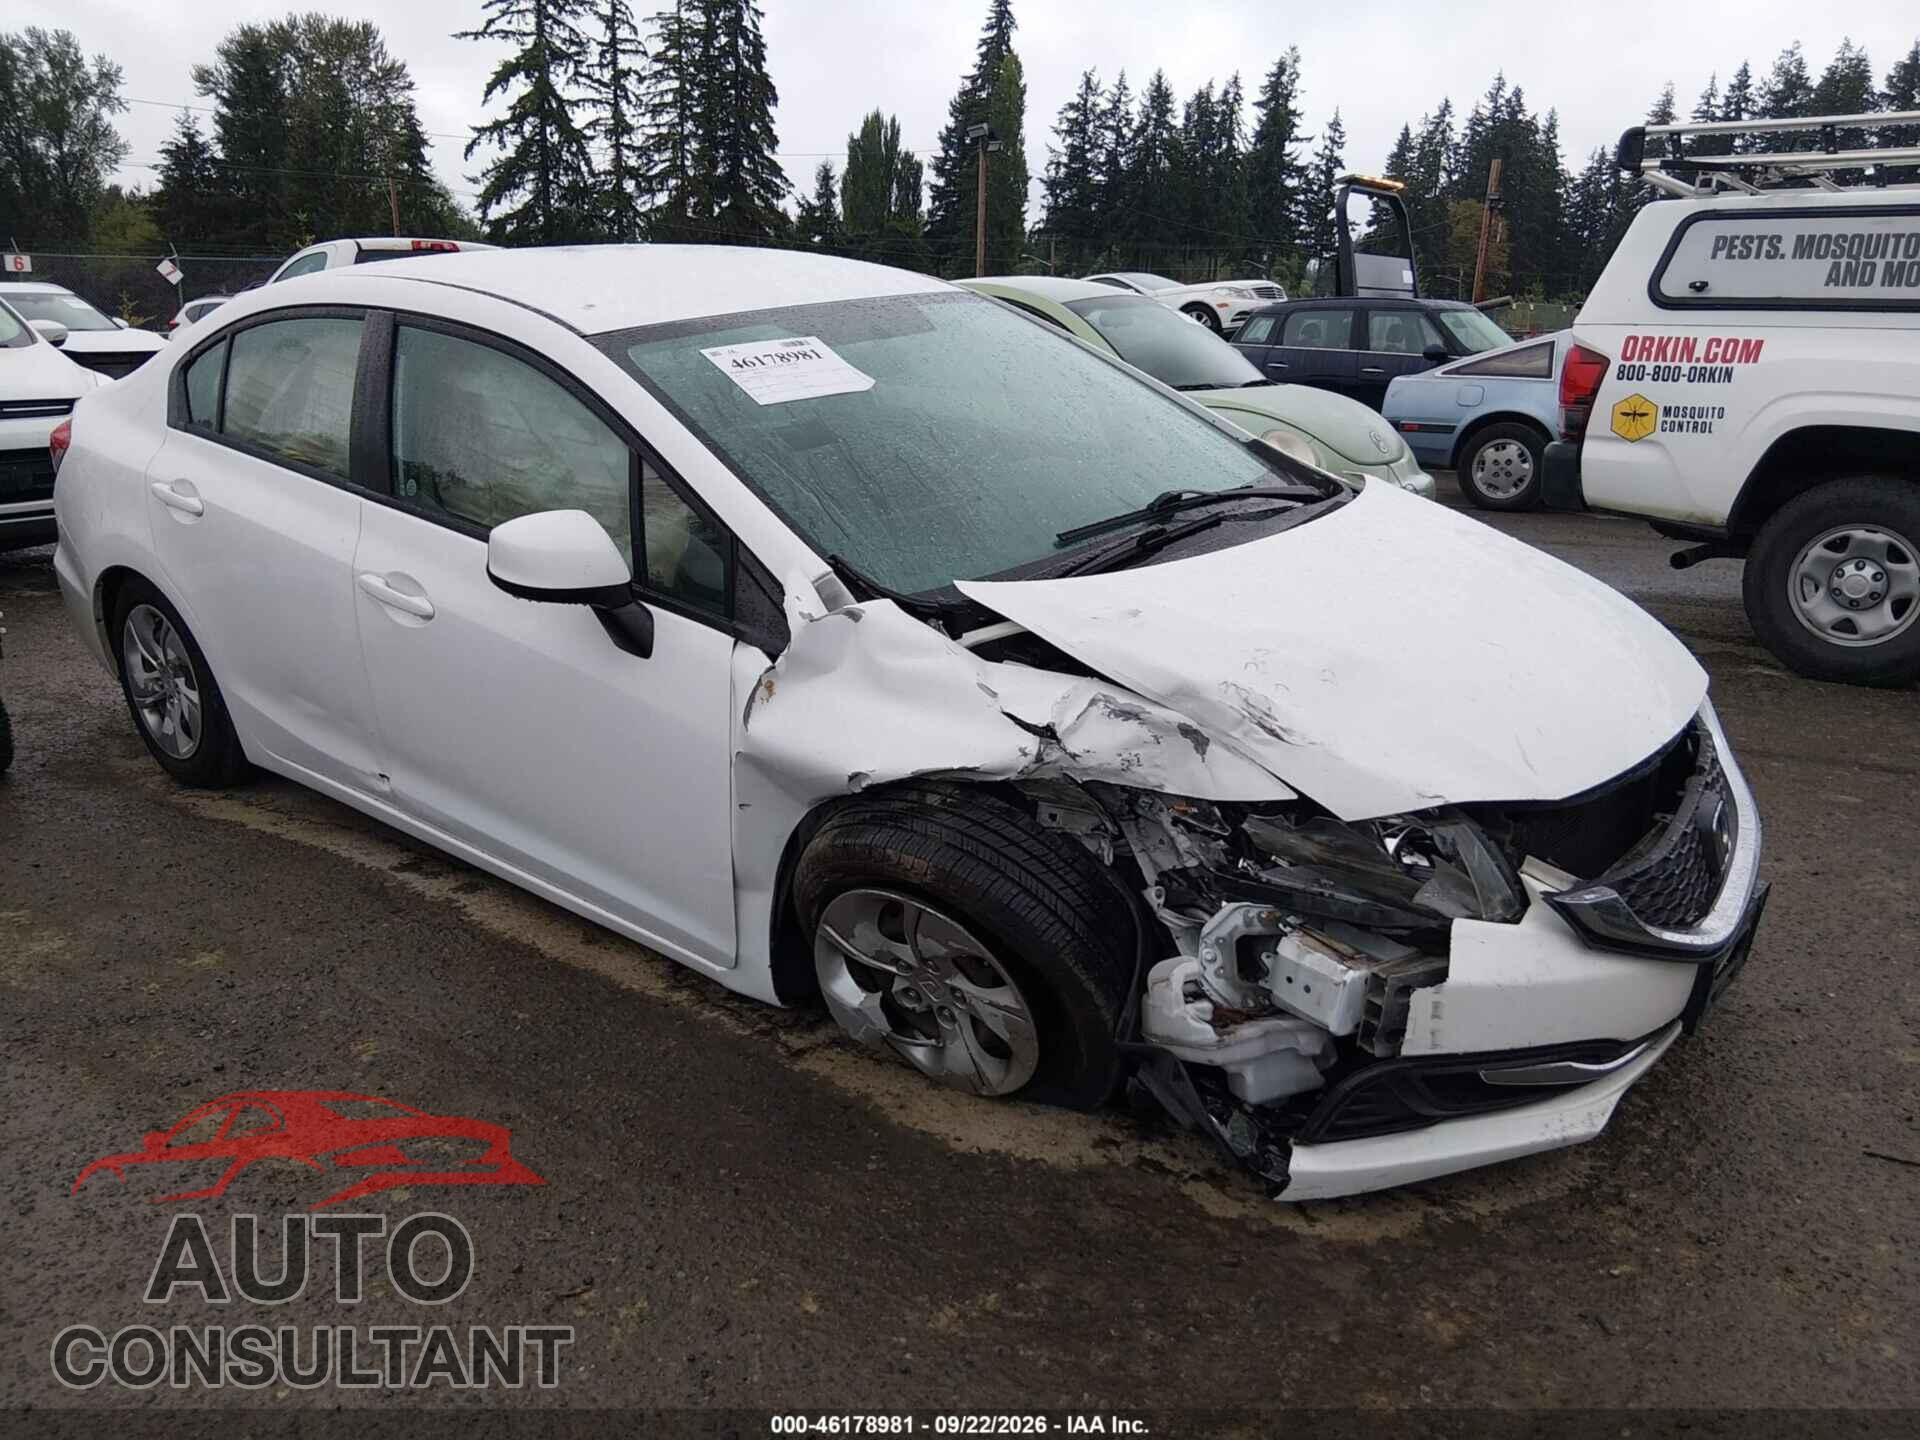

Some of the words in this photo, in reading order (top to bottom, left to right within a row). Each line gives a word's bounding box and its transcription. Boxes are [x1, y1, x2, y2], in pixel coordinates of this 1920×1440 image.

[1710, 234, 1786, 260] PESTS.
[1791, 232, 1920, 261] MOSQUITO
[13, 256, 25, 271] 6
[1823, 261, 1877, 288] AND
[1880, 260, 1920, 288] MO
[731, 348, 824, 370] 46178981
[1620, 335, 1764, 364] ORKIN.COM
[1616, 364, 1734, 384] 800-800-ORKIN
[1661, 405, 1725, 420] MOSQUITO
[1660, 420, 1713, 434] CONTROL
